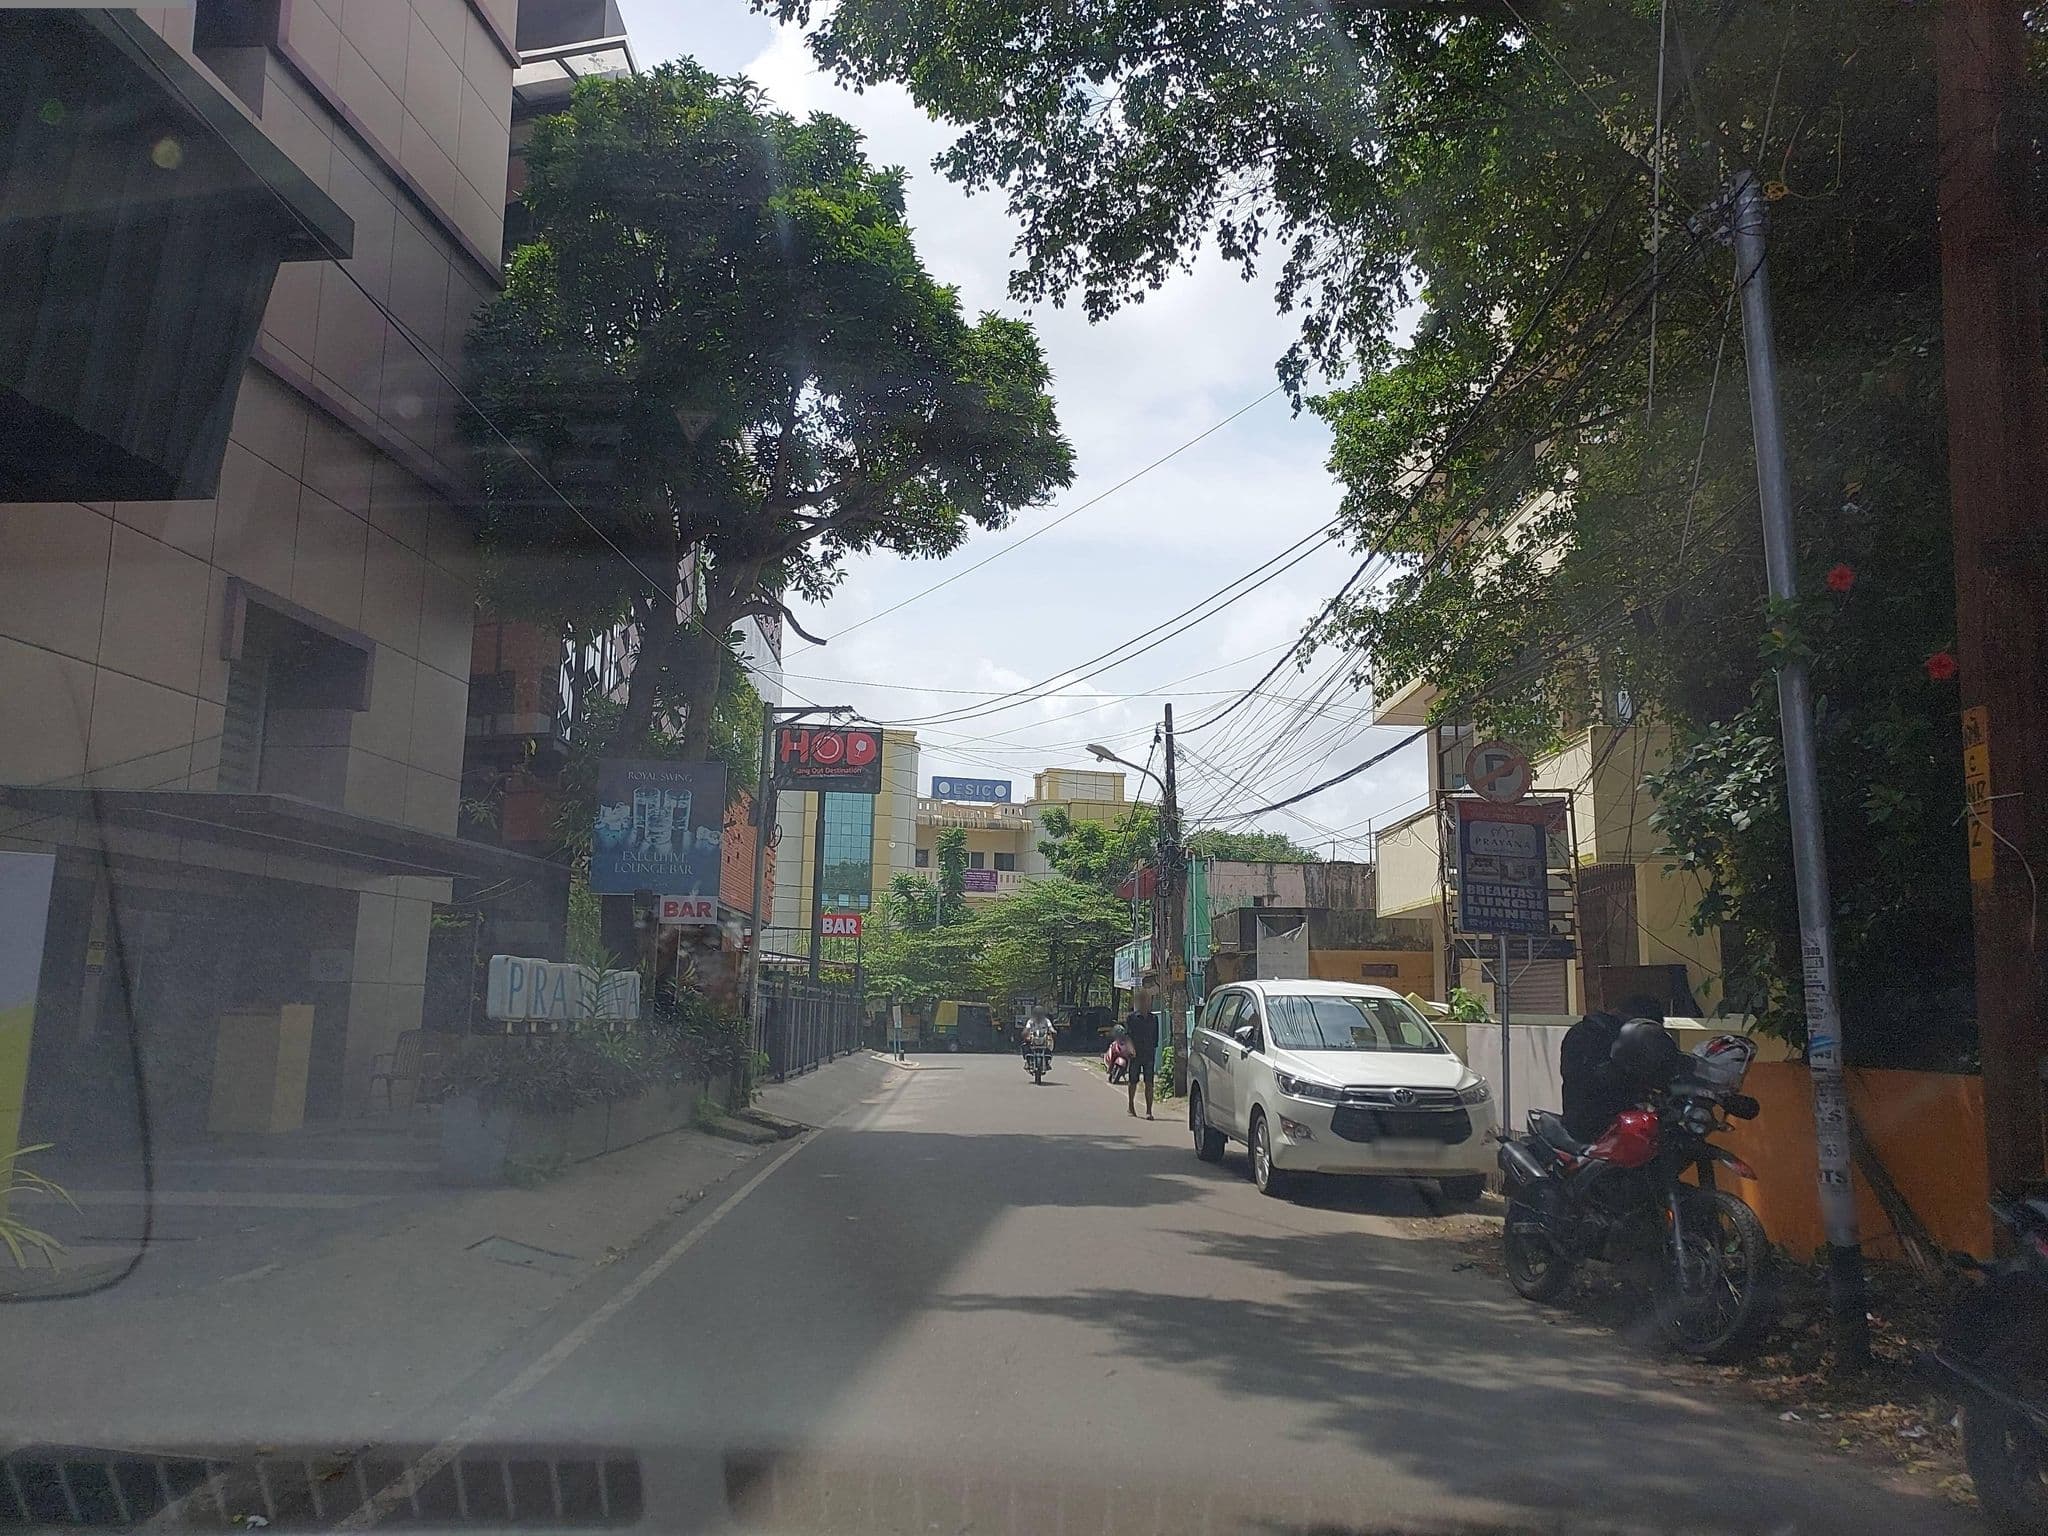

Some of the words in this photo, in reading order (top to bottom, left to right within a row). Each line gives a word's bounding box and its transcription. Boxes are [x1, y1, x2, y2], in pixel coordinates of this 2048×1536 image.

[780, 729, 877, 766] HOD
[628, 771, 657, 781] ROYAL
[660, 772, 694, 782] SWING
[953, 783, 991, 797] ESIC
[622, 850, 689, 862] EXECUTIVE
[614, 862, 667, 874] LOUNGE
[669, 864, 694, 876] BAR
[1466, 884, 1543, 900] BREAKFAST
[664, 901, 713, 918] BAR
[1466, 895, 1544, 910] LUNCH
[1466, 906, 1545, 921] DINNER
[822, 917, 858, 935] BAR
